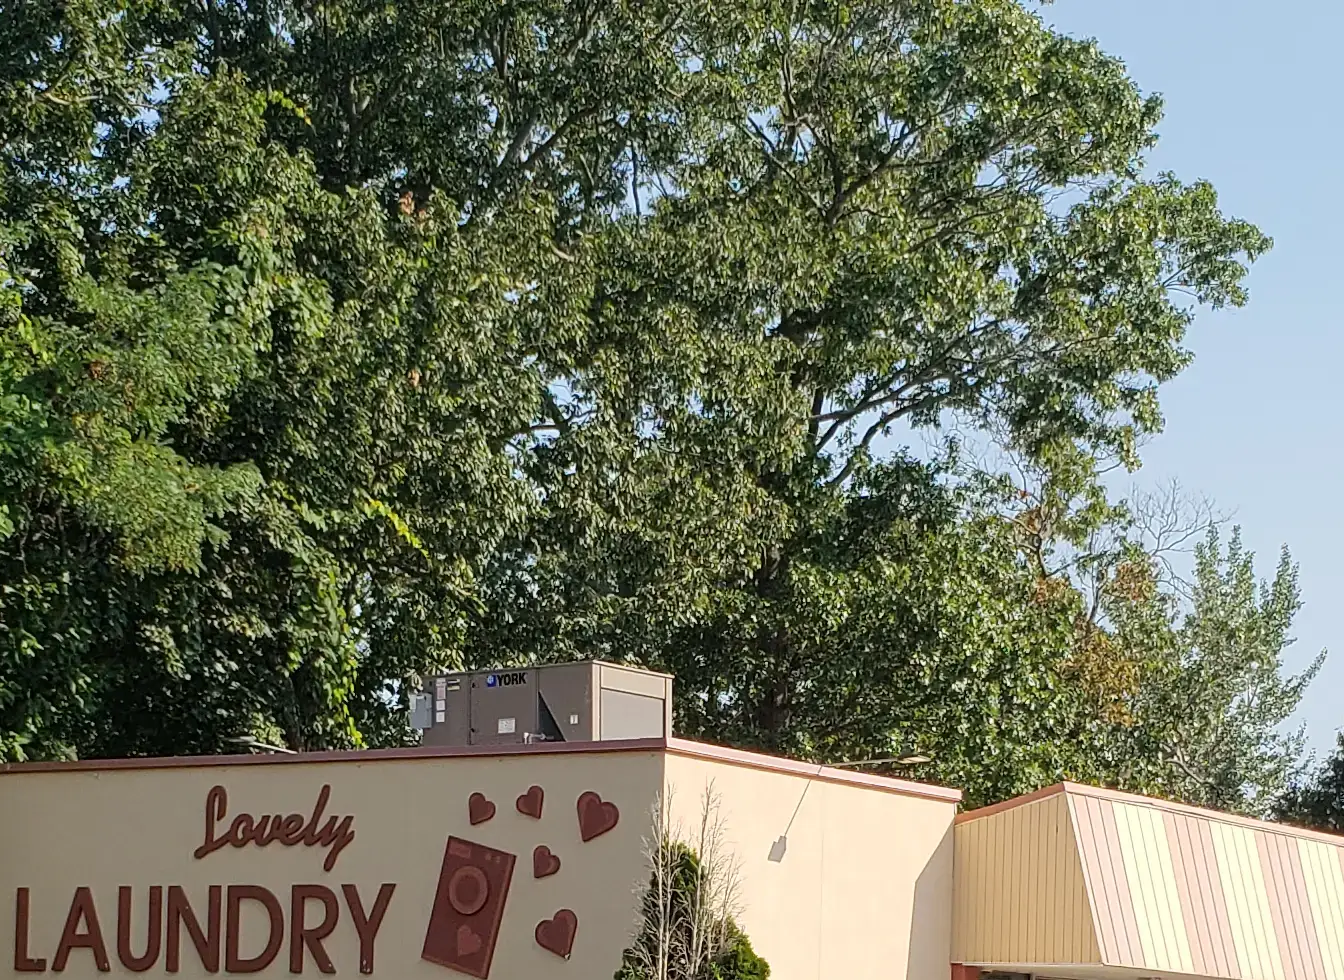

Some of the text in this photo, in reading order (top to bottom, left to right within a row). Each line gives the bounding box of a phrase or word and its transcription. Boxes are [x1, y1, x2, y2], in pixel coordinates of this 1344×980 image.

[497, 672, 527, 686] YORK
[194, 784, 355, 872] Lovely
[14, 883, 396, 974] LAUNDRY
